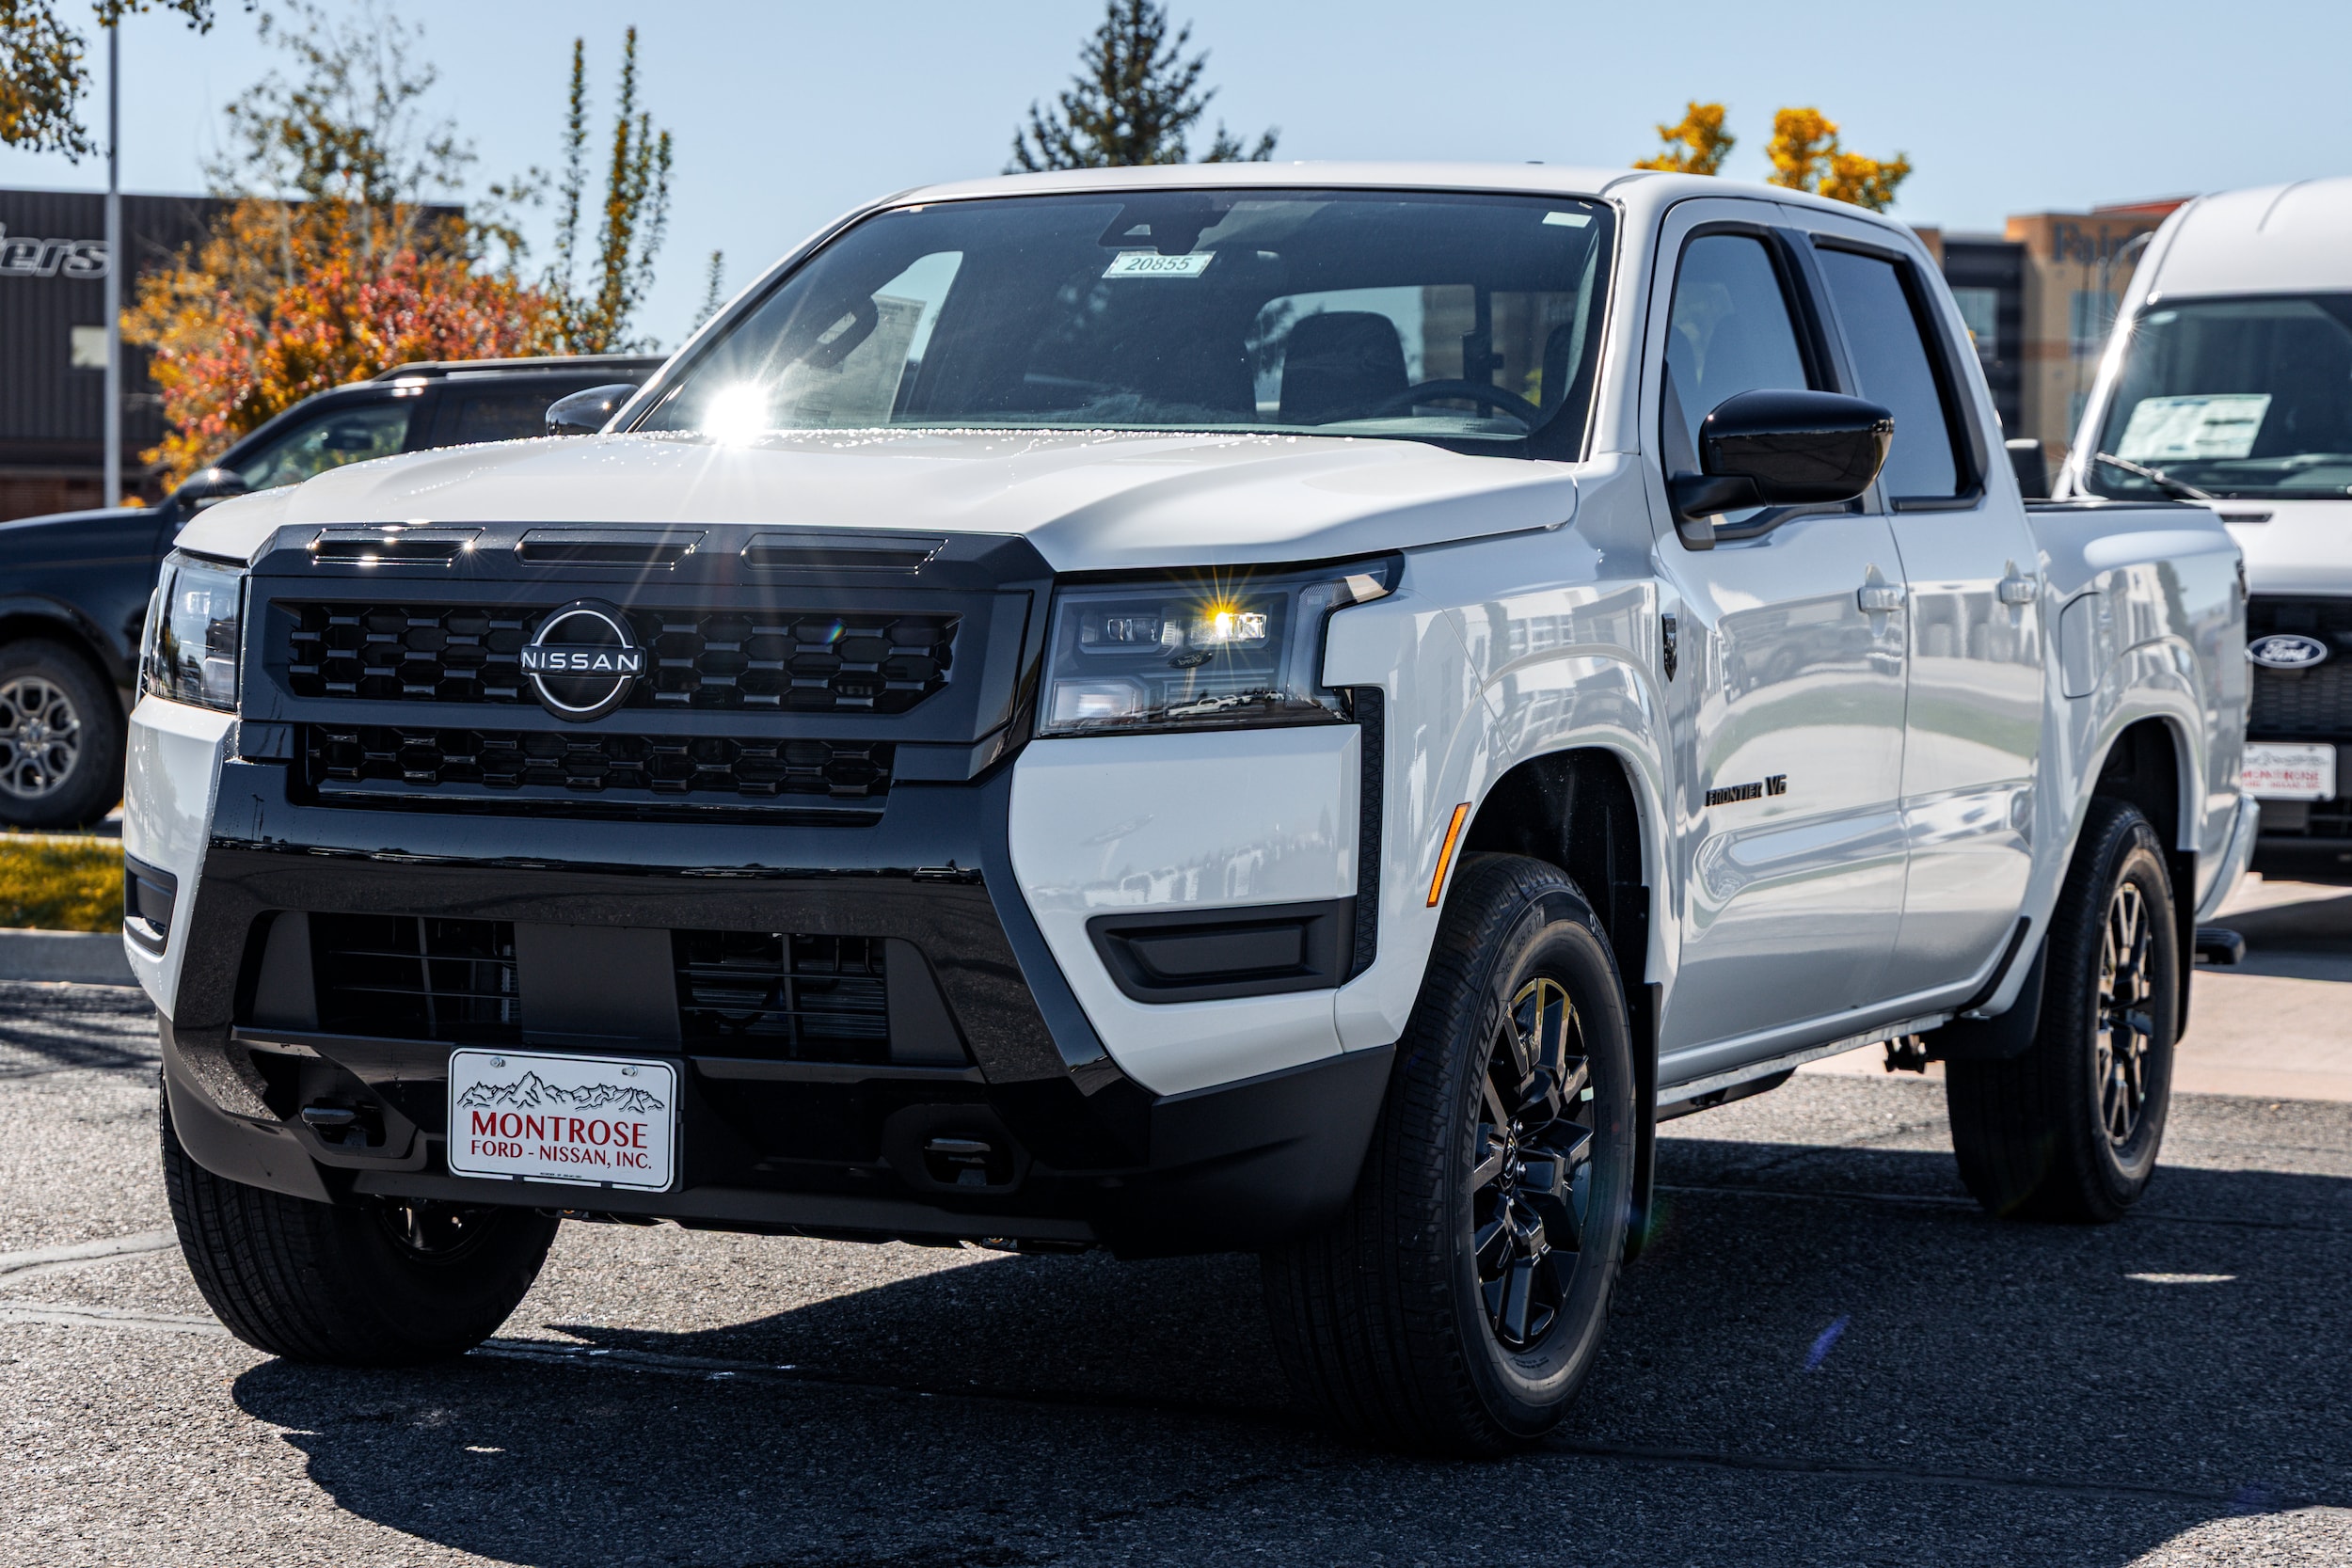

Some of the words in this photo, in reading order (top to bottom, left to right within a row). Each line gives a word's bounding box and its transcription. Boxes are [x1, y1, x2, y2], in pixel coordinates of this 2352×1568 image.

[1124, 257, 1192, 271] 20855
[522, 652, 638, 671] NISSAN
[2260, 639, 2312, 661] Ford
[1705, 782, 1763, 806] FRONTIER
[1765, 774, 1787, 796] V6
[1463, 998, 1498, 1166] MICHELIN
[471, 1111, 648, 1148] MONTROSE
[471, 1140, 523, 1158] FORD
[539, 1145, 611, 1168] NISSAN,
[616, 1151, 652, 1169] INC.
